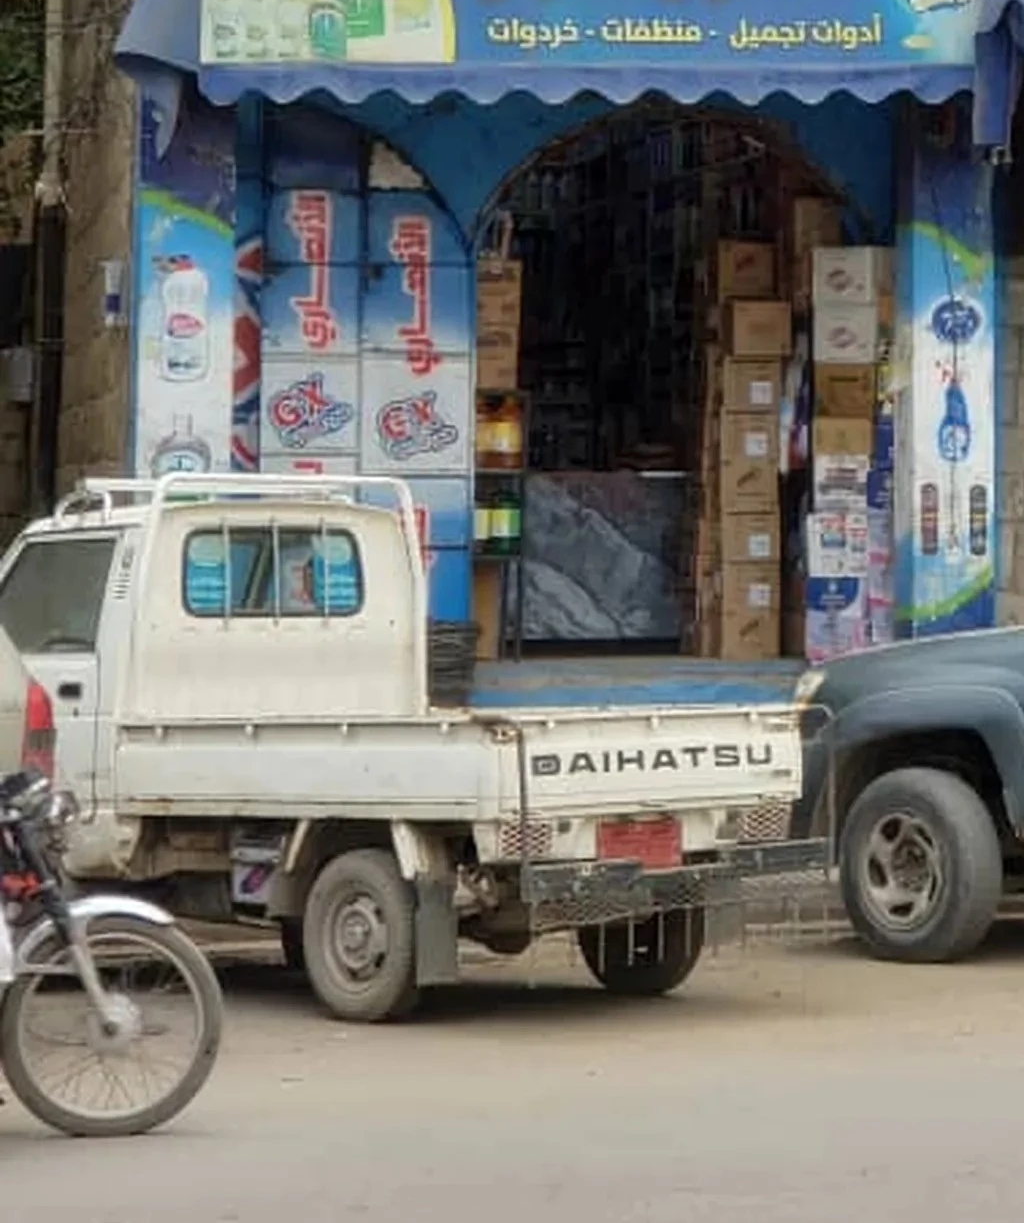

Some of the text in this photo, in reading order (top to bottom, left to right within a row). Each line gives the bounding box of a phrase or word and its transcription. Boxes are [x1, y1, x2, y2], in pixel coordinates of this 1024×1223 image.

[487, 17, 580, 50] خردوات
[602, 17, 702, 44] منظفات
[730, 19, 806, 51] تجميل
[812, 13, 882, 51] أدوات
[531, 742, 774, 777] DAIHATSU
